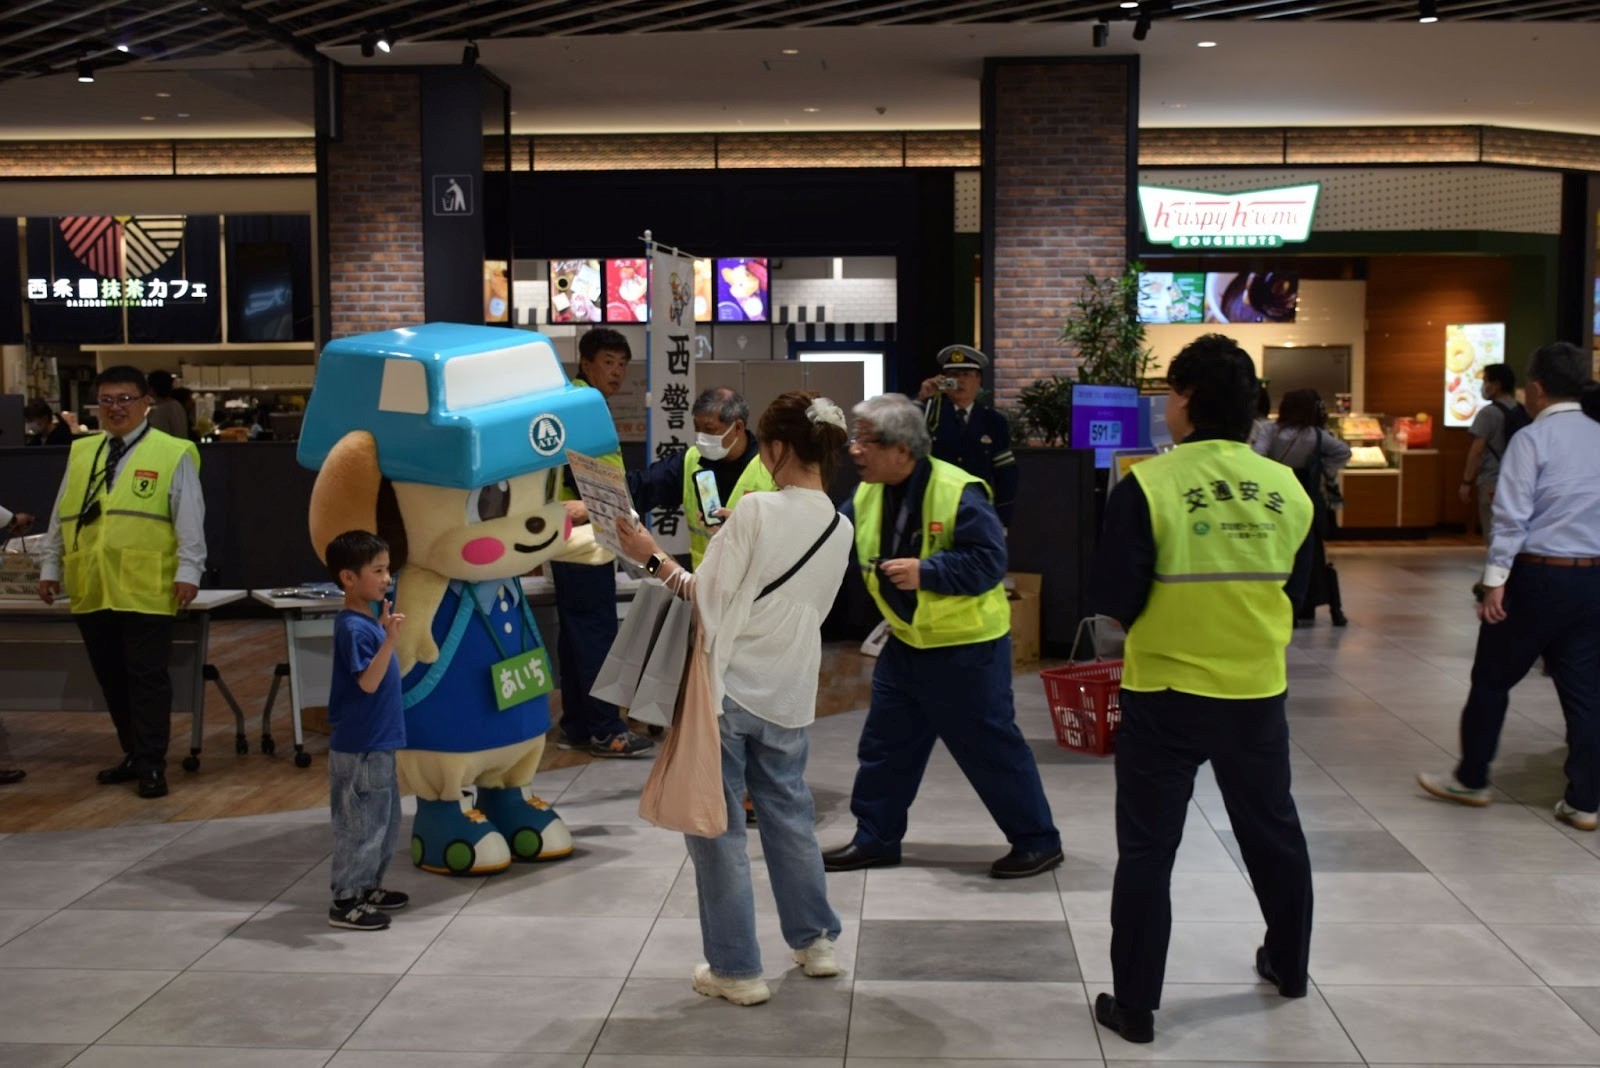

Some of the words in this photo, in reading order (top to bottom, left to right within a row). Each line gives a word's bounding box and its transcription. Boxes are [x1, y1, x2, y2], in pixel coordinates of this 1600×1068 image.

[1178, 235, 1276, 246] DOUGHNUTS
[1092, 424, 1108, 441] 591
[1183, 480, 1286, 515] 交通安全
[500, 657, 545, 699] あいち
[345, 908, 363, 922] N
